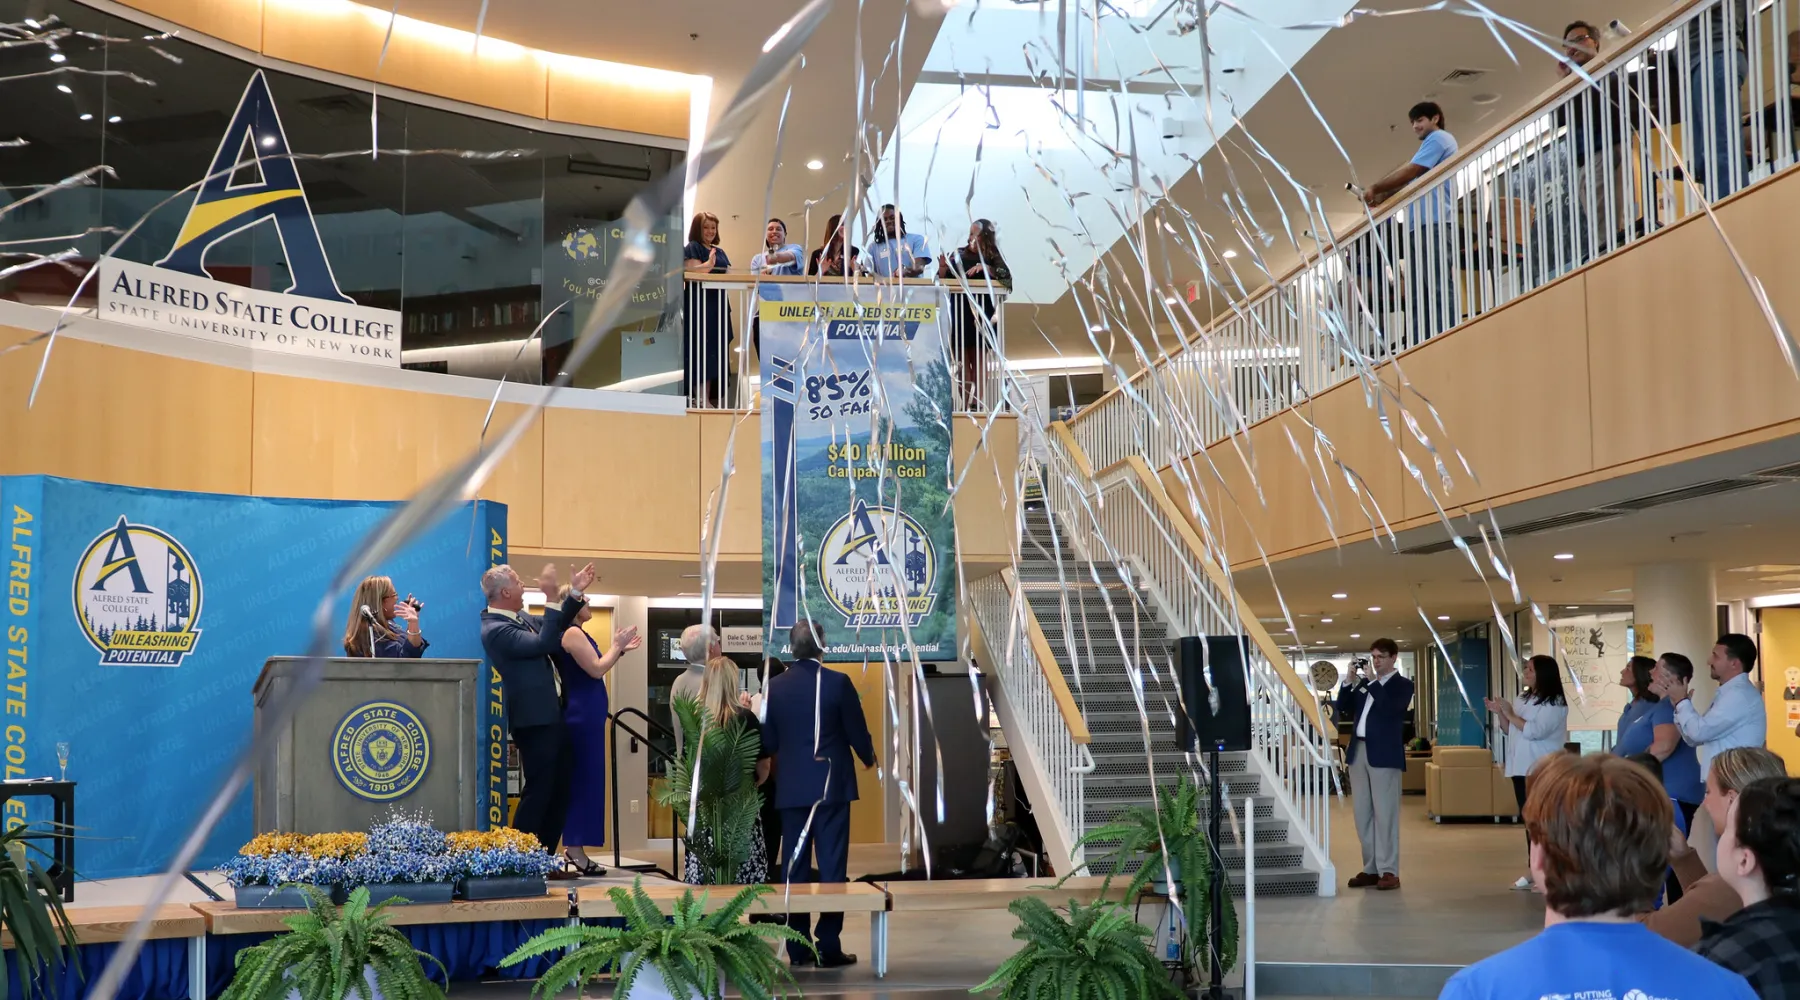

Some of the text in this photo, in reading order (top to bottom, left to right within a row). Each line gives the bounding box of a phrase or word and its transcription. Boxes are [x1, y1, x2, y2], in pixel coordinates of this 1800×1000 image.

[562, 278, 582, 294] You
[112, 270, 394, 342] ALFRED STATE COLLEGE
[885, 308, 932, 319] STTE'S
[109, 301, 394, 359] STATE UNIVERSITY OF NEW YORK
[805, 370, 871, 404] 85%
[809, 405, 833, 420] SO
[828, 444, 926, 463] $40 Mllion
[897, 465, 926, 478] Goal
[9, 504, 34, 616] ALFRED
[92, 595, 149, 605] ALFRED STATE
[856, 600, 927, 610] UNLEASING
[102, 604, 140, 614] COLLEGE
[1564, 626, 1585, 634] OPEN
[113, 633, 190, 647] UNLEASHING
[1565, 637, 1585, 645] ROCK
[108, 650, 175, 663] POTENTIAL
[1566, 648, 1589, 656] WALL
[6, 625, 28, 718] STATE
[491, 666, 503, 718] ATE
[340, 709, 422, 772] ALFRED STATE COLLEGE
[369, 783, 395, 792] 1908
[1574, 990, 1612, 999] PUTTING
